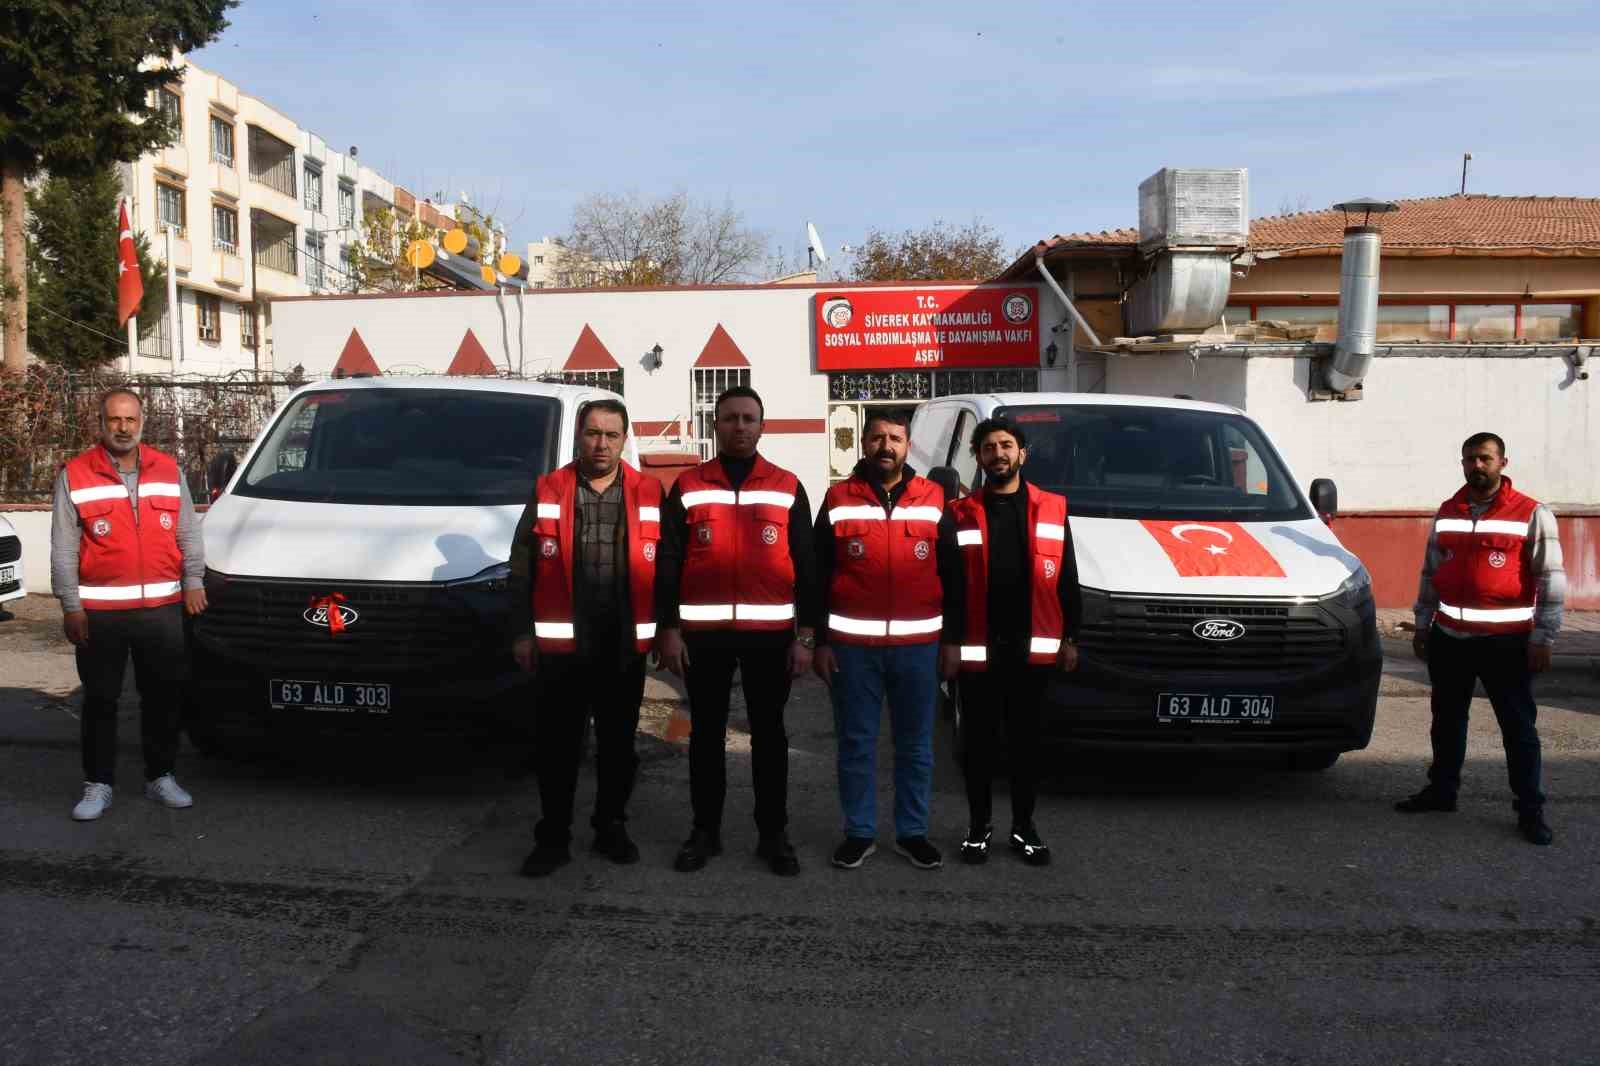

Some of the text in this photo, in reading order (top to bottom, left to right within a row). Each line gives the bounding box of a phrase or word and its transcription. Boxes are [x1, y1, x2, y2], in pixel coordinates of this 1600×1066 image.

[916, 296, 939, 308] T.C.
[865, 312, 910, 327] SİVEREK
[912, 309, 992, 326] KAYMAKAMLIĞI
[825, 333, 861, 347] SOSYAL
[864, 332, 931, 347] YARDIMLAŞMA
[934, 331, 946, 344] VE
[949, 330, 1002, 345] DAYANIŞMA
[915, 347, 944, 365] AŞEVİ
[1202, 622, 1236, 637] Ford
[282, 683, 387, 706] 63 ALD 303
[1169, 697, 1270, 717] 63 ALD 304
